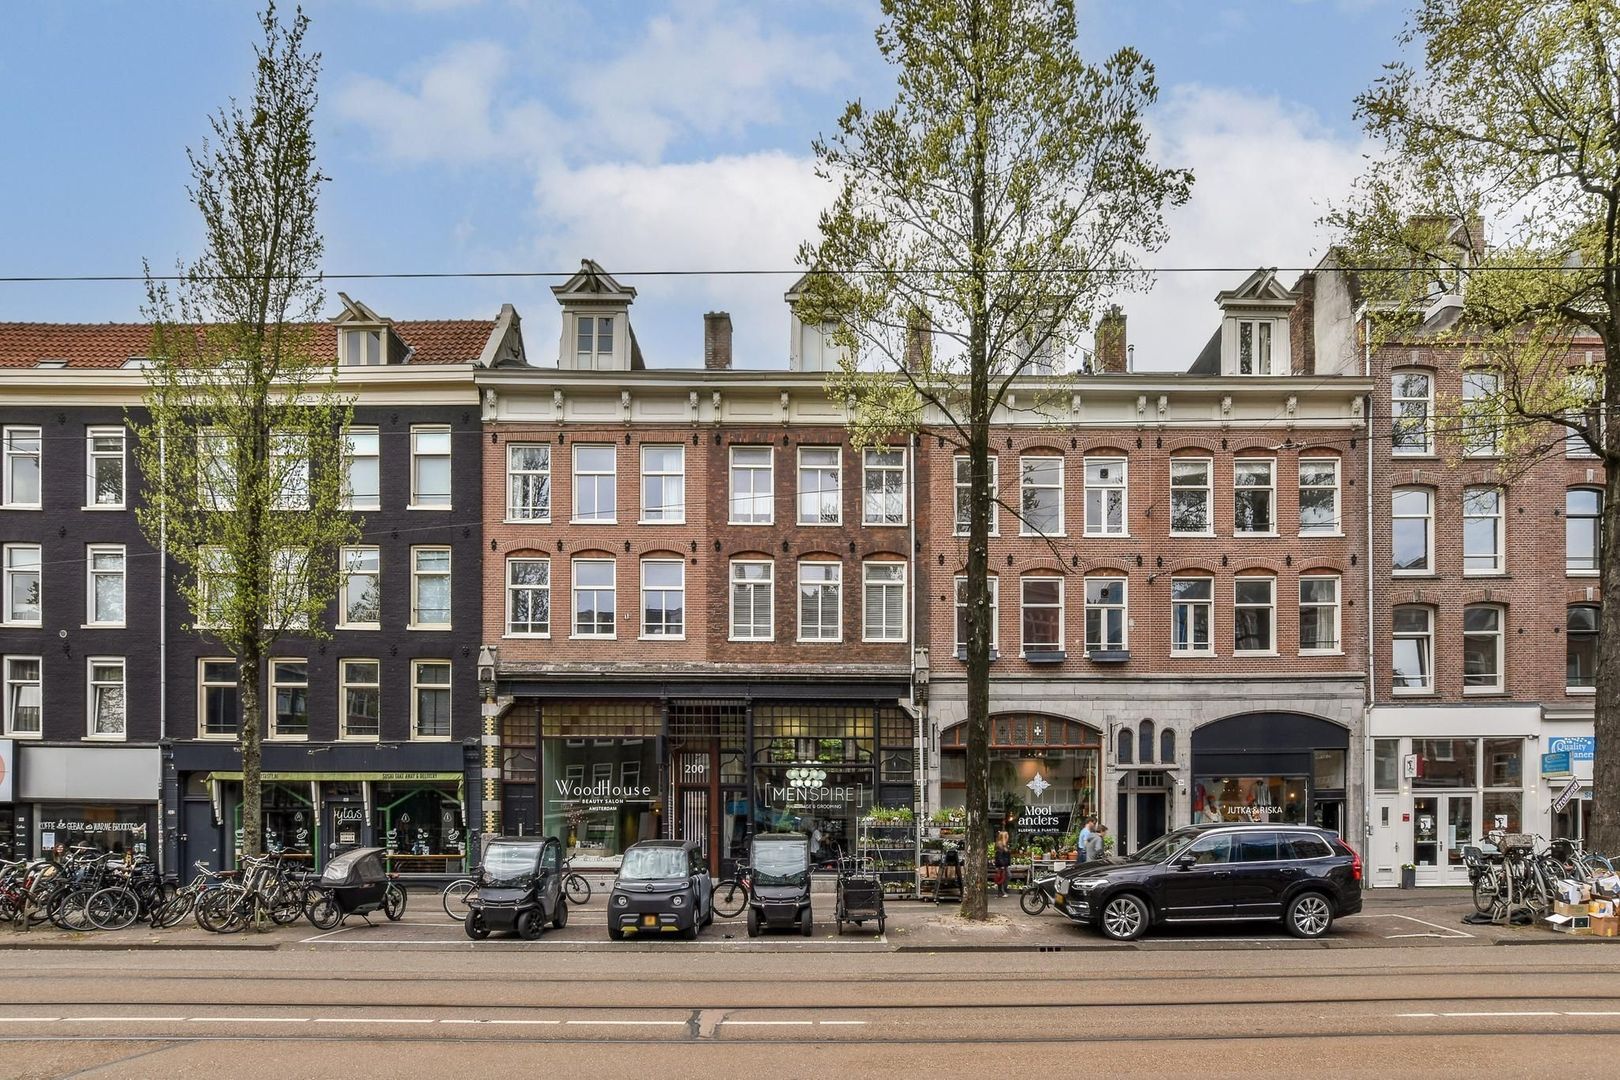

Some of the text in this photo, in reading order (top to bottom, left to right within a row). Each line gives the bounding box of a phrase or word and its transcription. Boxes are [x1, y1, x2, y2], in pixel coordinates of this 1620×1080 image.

[1556, 742, 1587, 752] Quality
[684, 764, 704, 774] 200
[555, 779, 651, 796] WoodHouse
[773, 787, 855, 802] MENSPIRE
[1227, 806, 1252, 815] JUTKA
[1260, 806, 1283, 815] RISKA
[1018, 815, 1060, 826] anders
[66, 822, 85, 831] GEBAK
